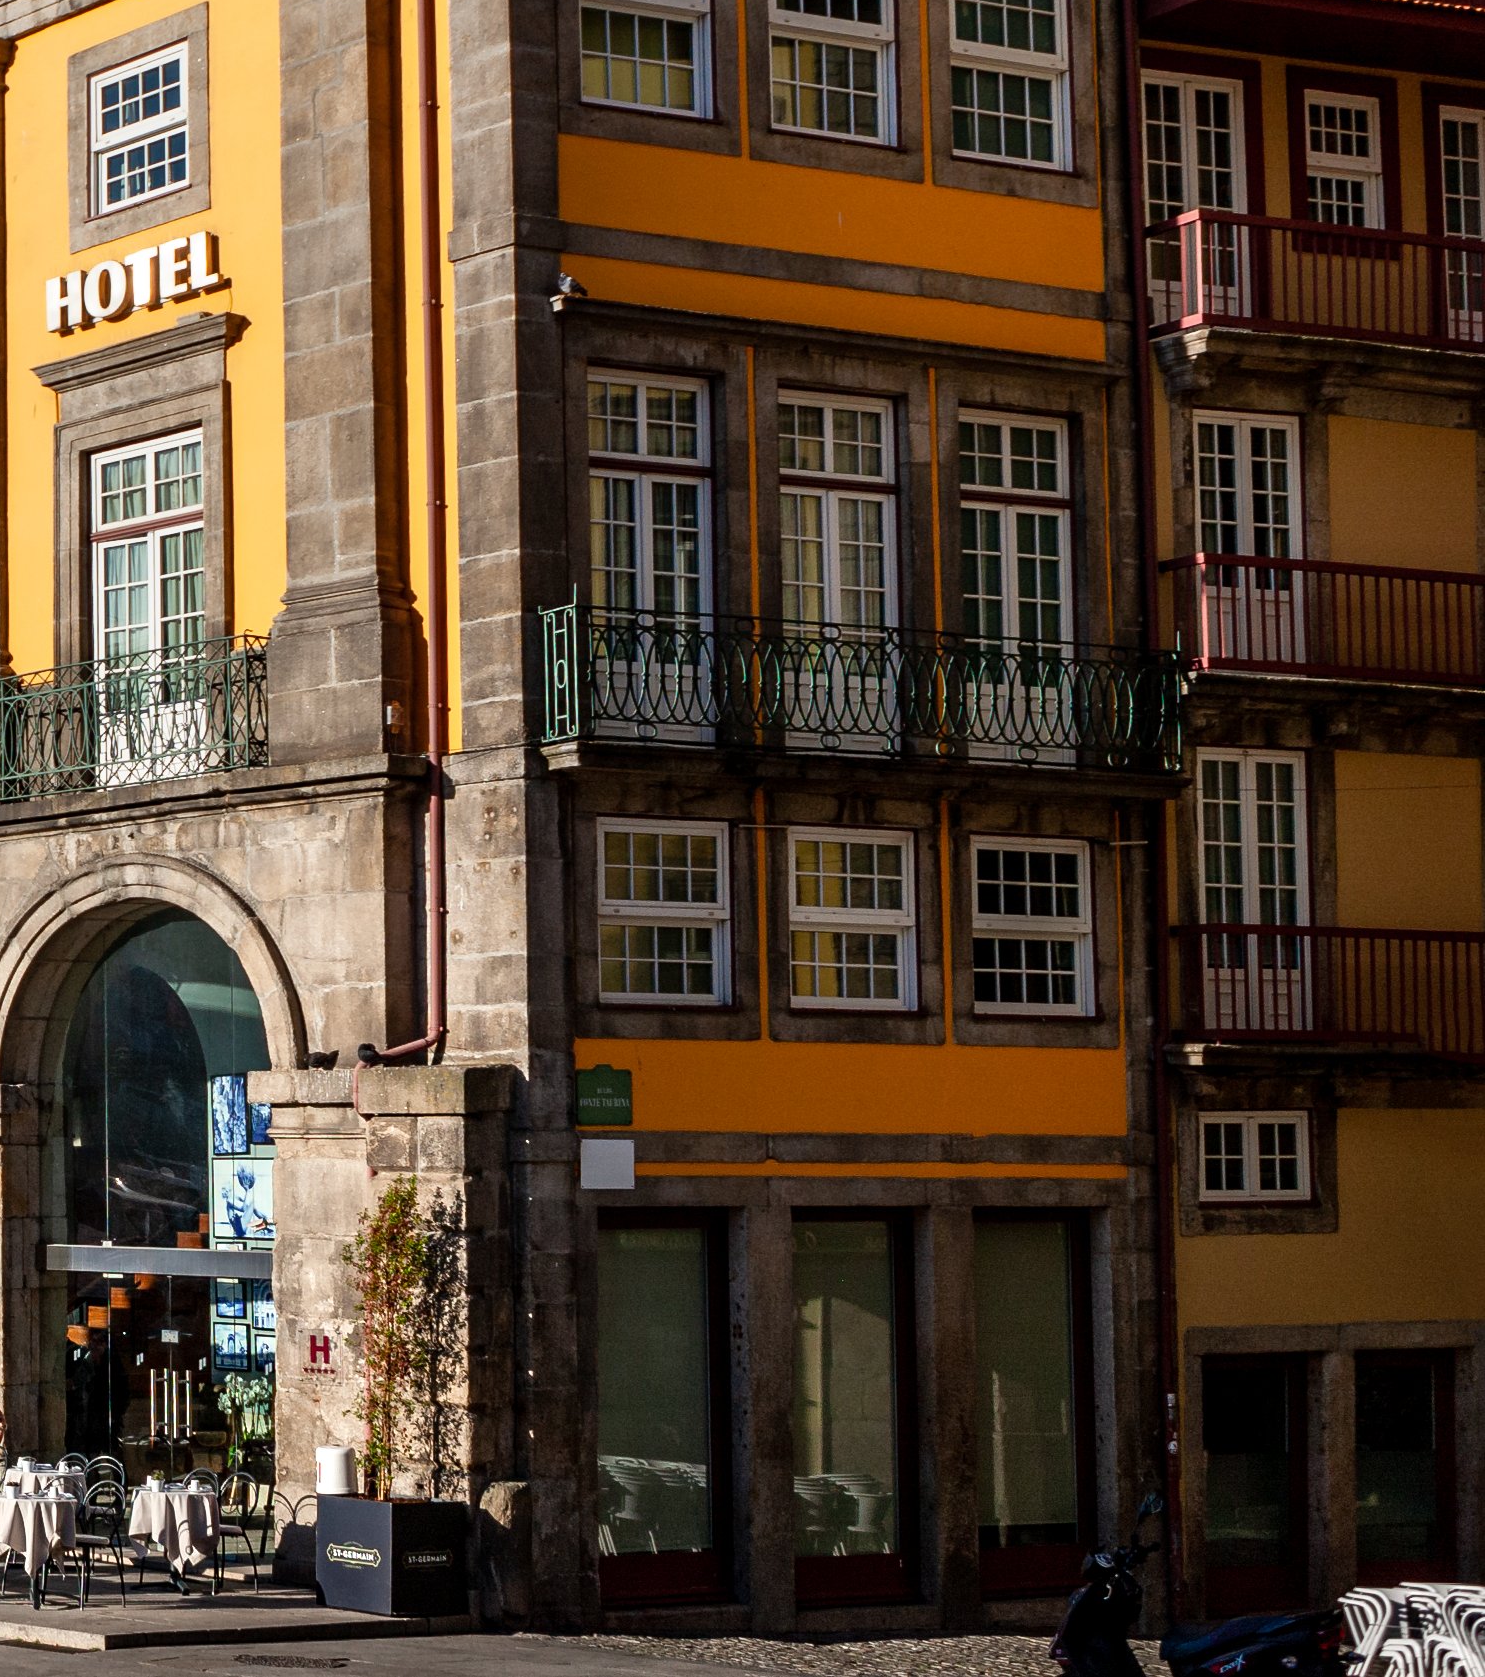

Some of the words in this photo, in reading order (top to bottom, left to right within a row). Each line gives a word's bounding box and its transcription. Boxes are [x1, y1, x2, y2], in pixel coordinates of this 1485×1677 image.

[46, 230, 219, 333] HOTEL
[309, 1334, 331, 1364] H
[332, 1548, 375, 1562] ST-GERMAIN
[408, 1554, 447, 1564] ST-GERMAIN
